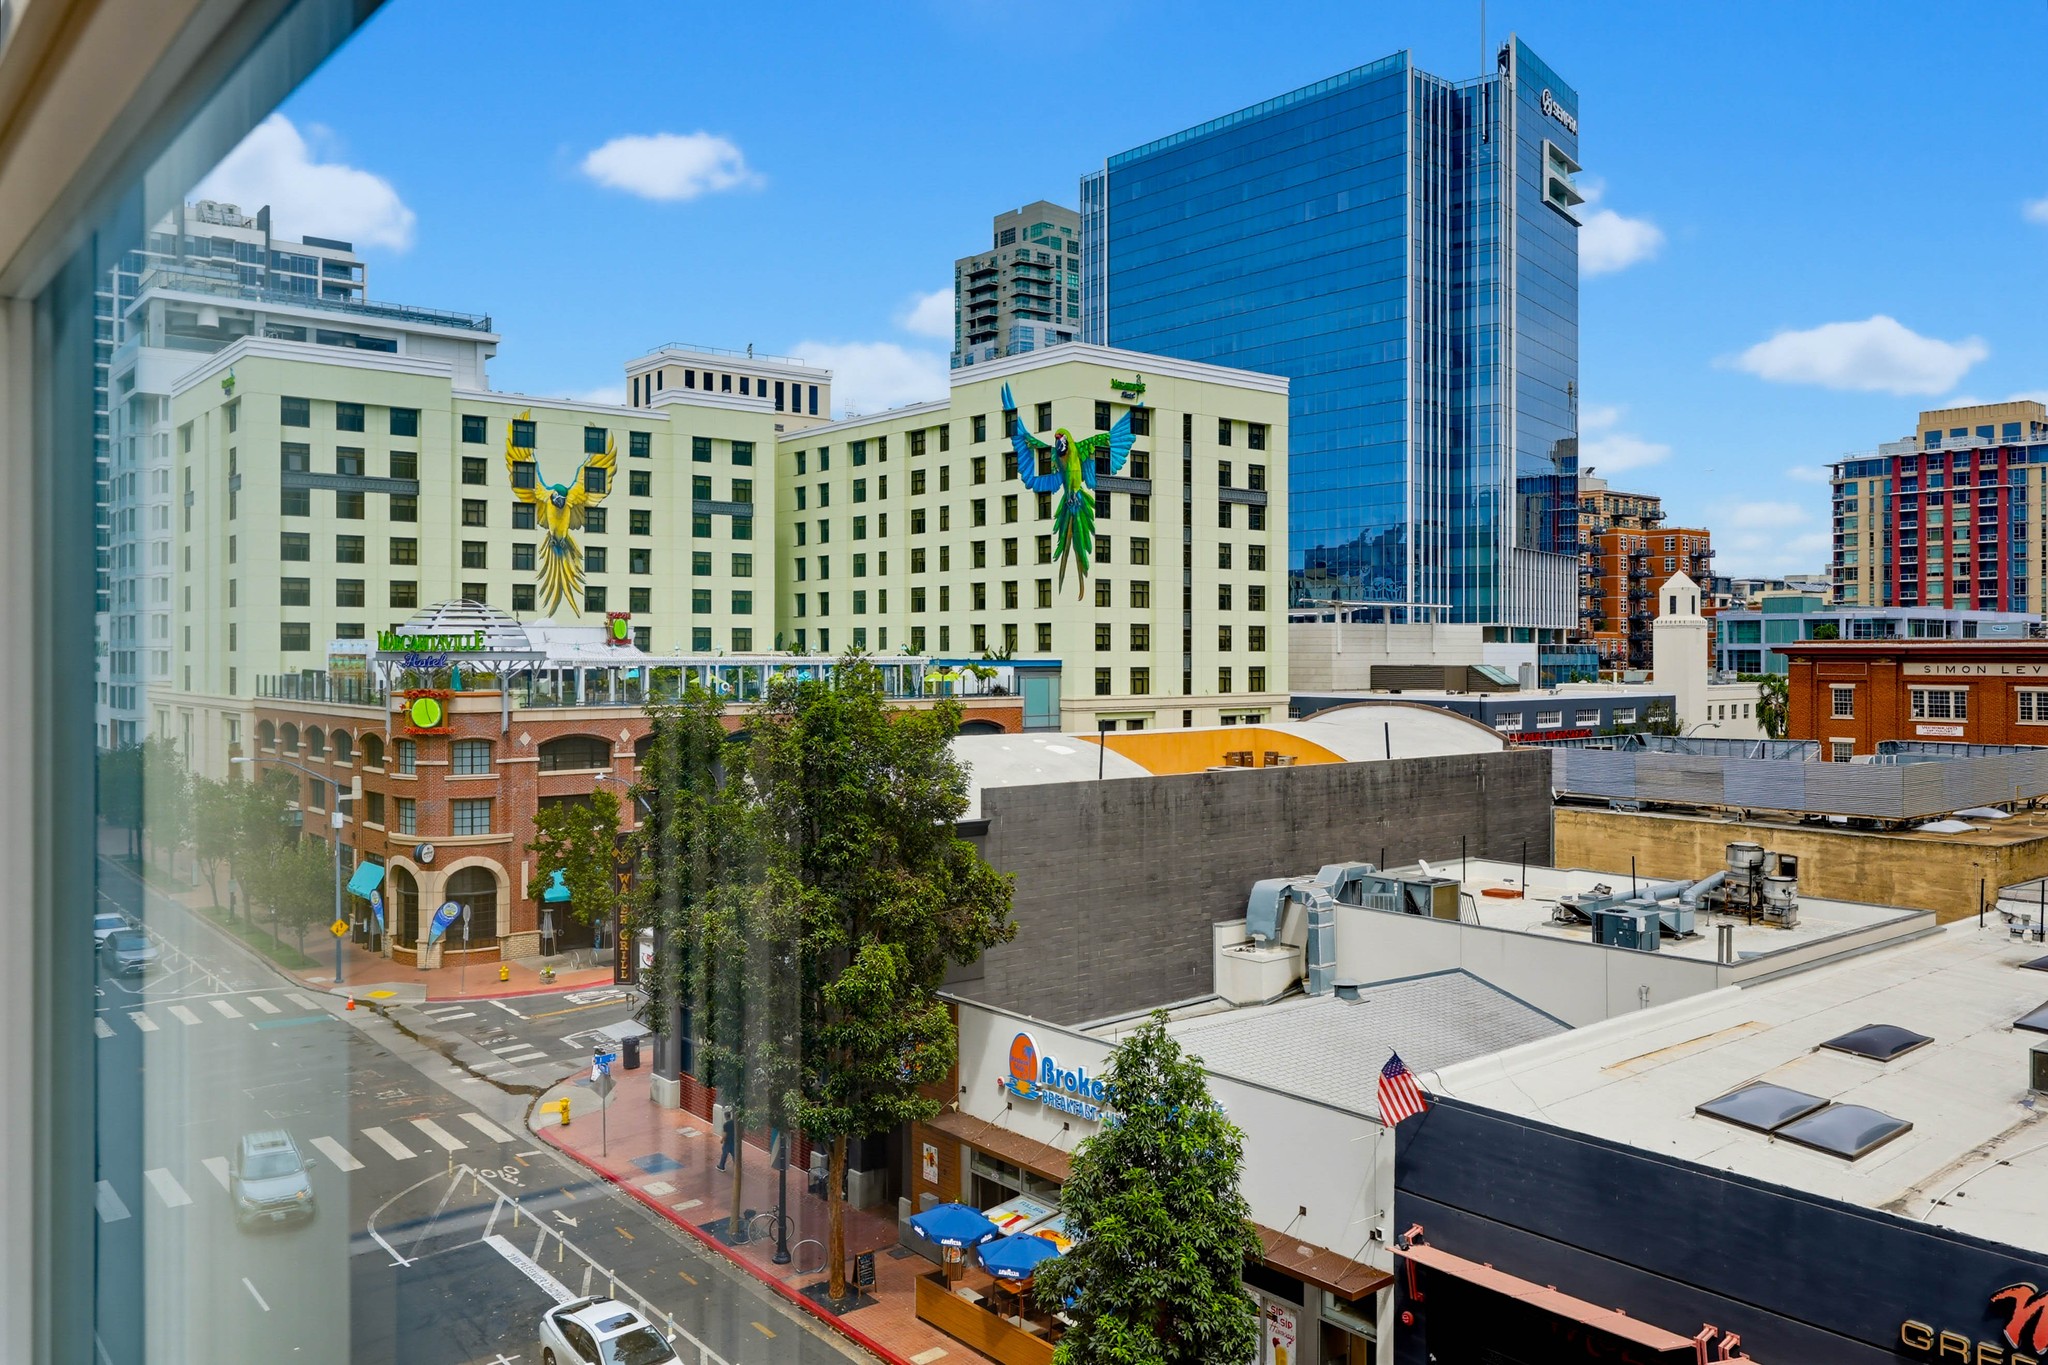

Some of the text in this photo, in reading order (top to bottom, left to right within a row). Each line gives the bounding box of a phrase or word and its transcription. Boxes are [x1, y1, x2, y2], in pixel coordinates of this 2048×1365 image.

[1552, 101, 1578, 135] SEMPRA
[402, 652, 448, 669] Hotel
[1923, 665, 1987, 674] SIMON
[617, 873, 632, 925] WAER
[618, 929, 632, 979] GRILL
[1041, 1056, 1117, 1104] Broke
[1042, 1089, 1100, 1122] BREAKFAST
[1901, 1319, 2039, 1365] GRE
